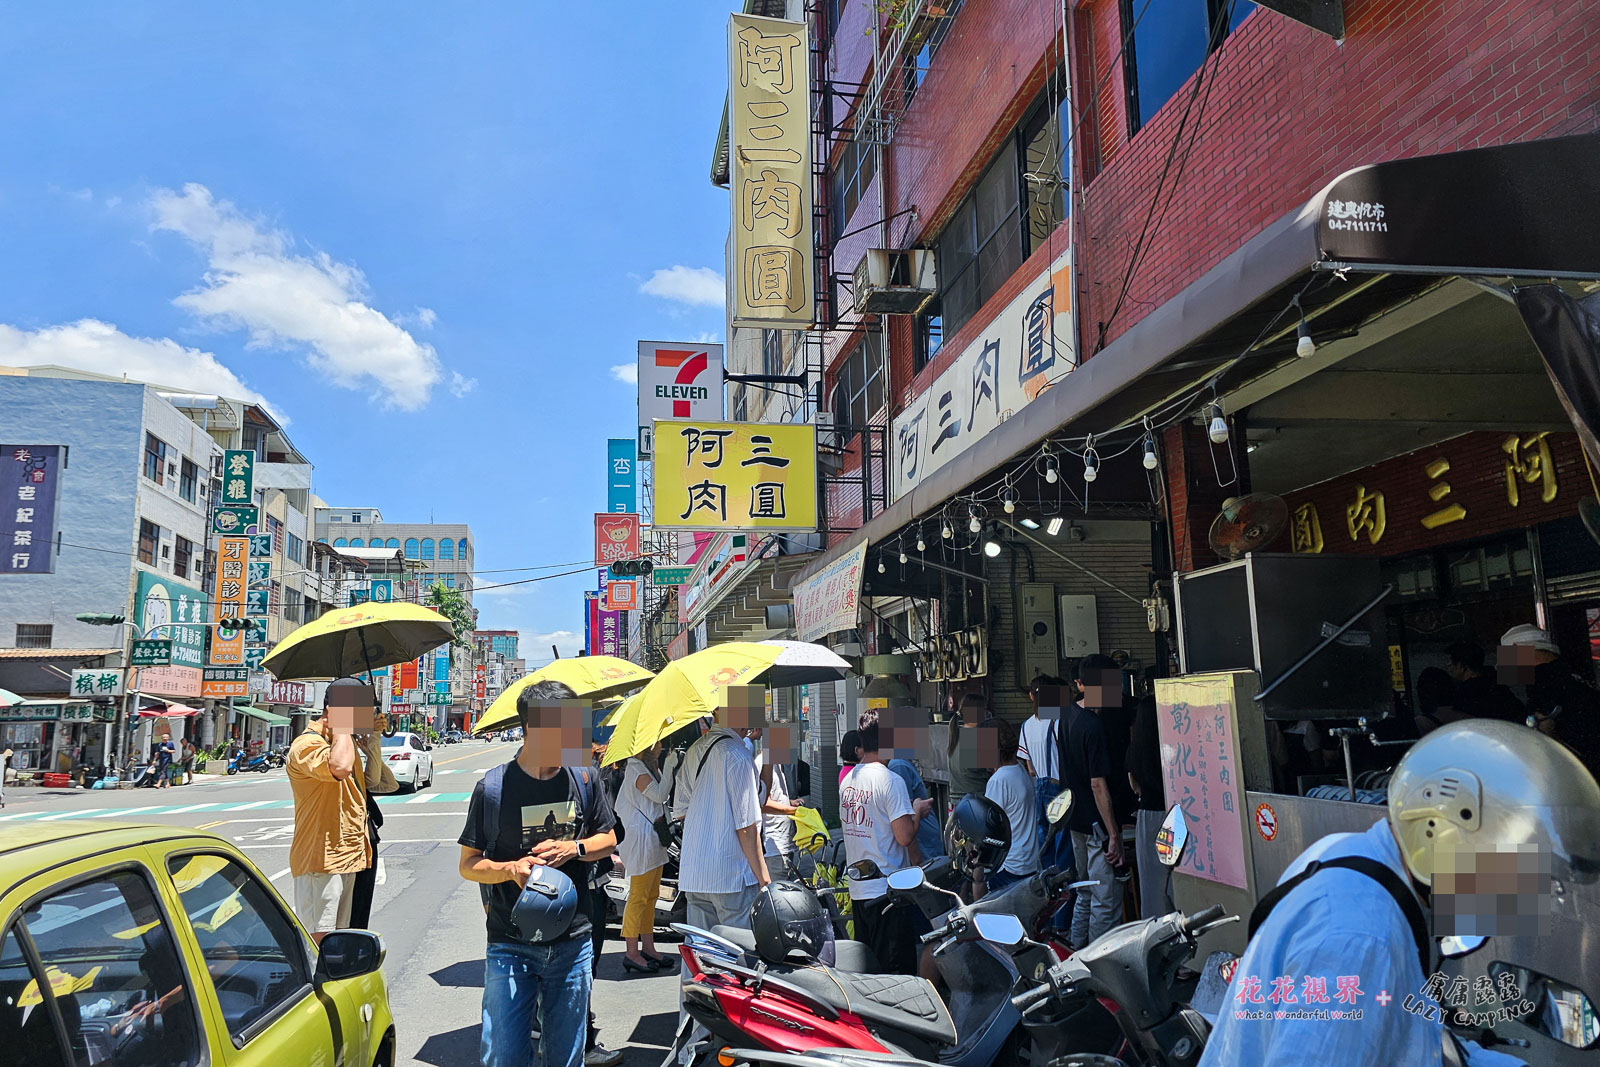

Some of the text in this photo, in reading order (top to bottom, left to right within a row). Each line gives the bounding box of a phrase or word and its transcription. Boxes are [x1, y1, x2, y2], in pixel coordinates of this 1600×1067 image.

[738, 26, 806, 313] 阿三肉圓
[1329, 219, 1388, 232] 04-7111711
[899, 284, 1055, 487] 阿三肉圓
[680, 427, 790, 468] 阿三
[227, 454, 250, 499] 登雅
[680, 479, 786, 522] 肉圓
[12, 485, 36, 568] 老紀茶行
[601, 543, 628, 553] EASY
[603, 551, 634, 561] SHOP
[219, 541, 244, 618] 牙醫診所
[75, 673, 118, 694] 檳榔
[203, 683, 246, 693] 人工植牙
[1214, 714, 1235, 814] 阿三肉圓
[1170, 702, 1205, 872] 彰化之光
